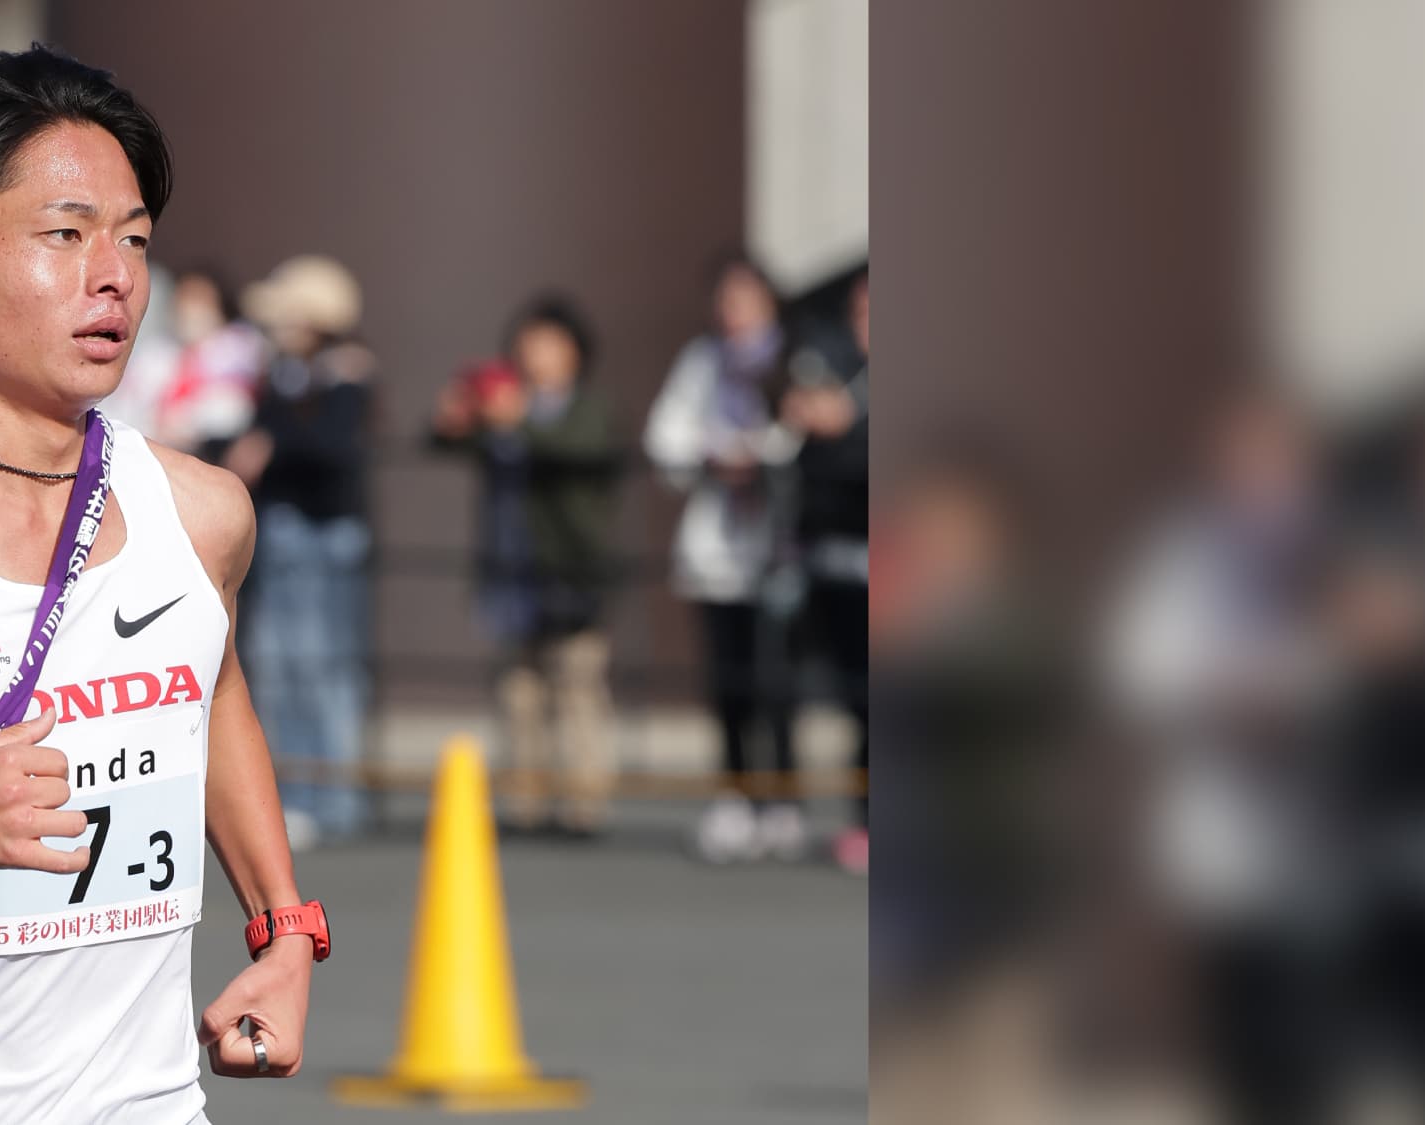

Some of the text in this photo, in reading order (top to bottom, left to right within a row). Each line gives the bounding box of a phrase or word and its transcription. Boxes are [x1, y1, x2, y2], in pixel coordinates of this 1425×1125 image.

[76, 748, 156, 789] nda
[17, 899, 180, 946] 彩の国実業団駅伝
